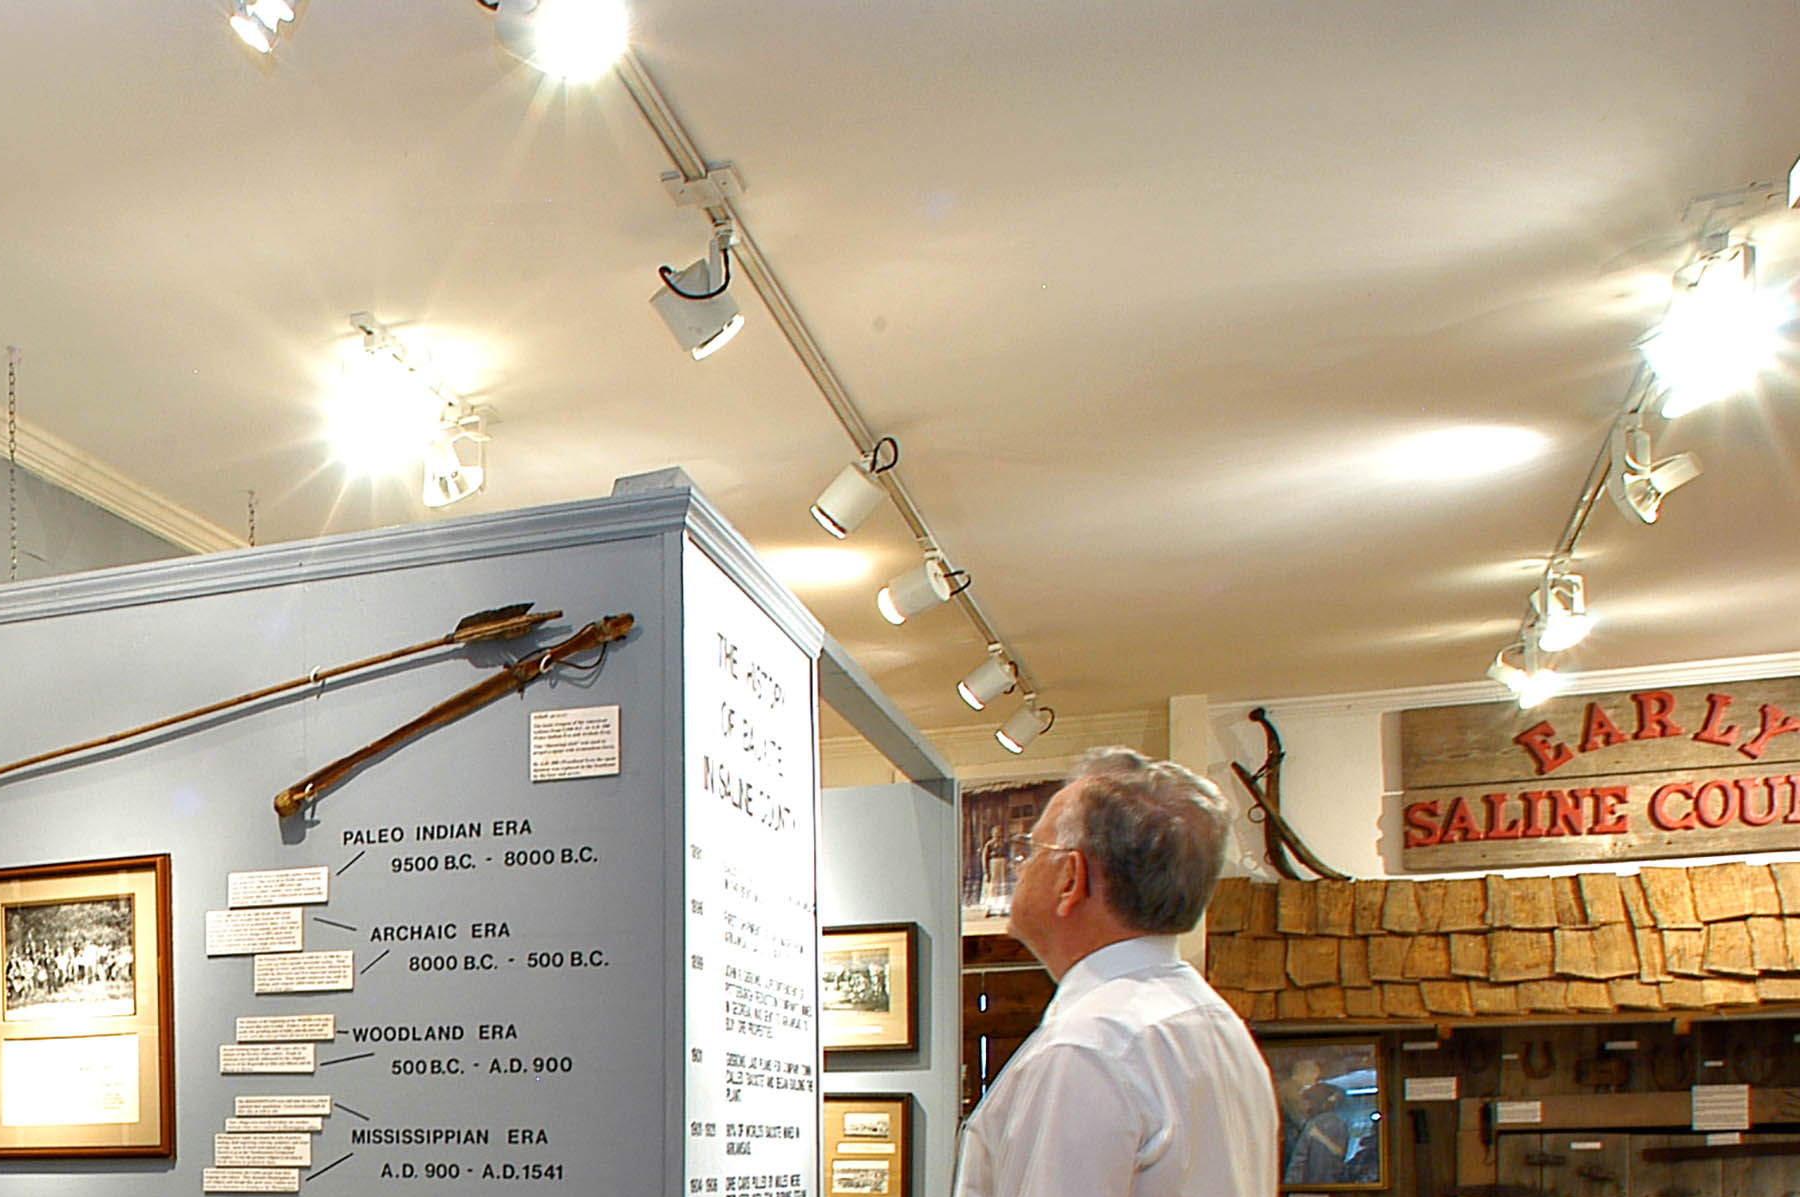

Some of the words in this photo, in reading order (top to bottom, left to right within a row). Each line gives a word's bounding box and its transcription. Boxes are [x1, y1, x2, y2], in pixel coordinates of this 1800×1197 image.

[747, 662, 785, 709] HISTR
[1513, 691, 1800, 776] EARLY
[1403, 786, 1630, 848] SALINE
[343, 827, 404, 846] PALEO
[416, 823, 481, 841] INDIAN
[493, 820, 533, 836] ERA
[391, 856, 438, 872] 9500
[445, 854, 475, 870] B.C.
[504, 849, 554, 866] 8000
[561, 847, 597, 864] B.C.
[370, 924, 457, 942] ARCHAIC
[472, 923, 511, 938] ERA
[409, 956, 457, 971] 8000
[464, 954, 498, 970] B.C.
[528, 952, 563, 968] 500
[571, 950, 609, 967] B.C.
[352, 1025, 464, 1042] WOODLAND
[479, 1024, 518, 1040] ERA
[533, 1057, 572, 1072] 900
[352, 1129, 489, 1144] MISSISSIPPIAN
[508, 1129, 549, 1144] ERA
[381, 1163, 418, 1178] A.D.
[425, 1164, 460, 1179] 900
